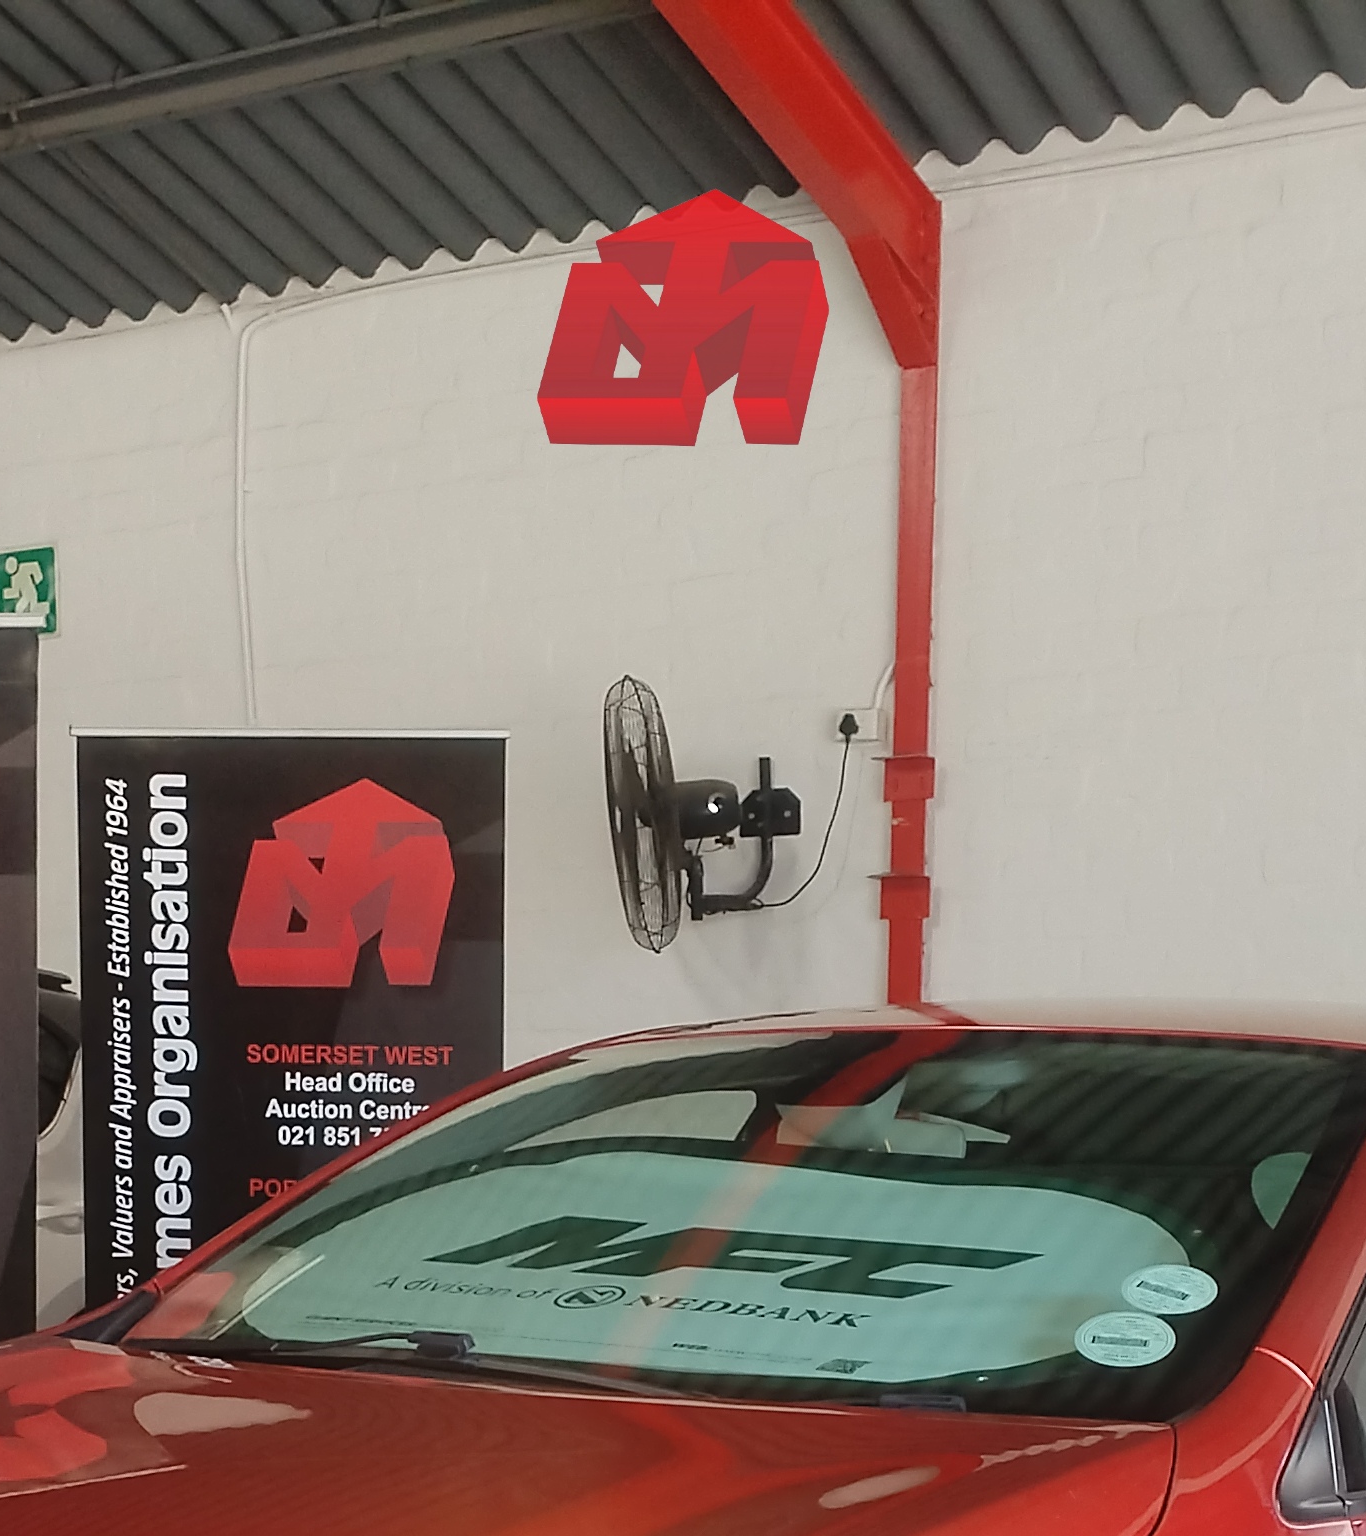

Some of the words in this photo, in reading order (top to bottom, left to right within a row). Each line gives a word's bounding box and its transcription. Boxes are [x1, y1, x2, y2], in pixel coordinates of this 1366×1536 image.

[105, 777, 129, 837] 1964
[104, 841, 130, 977] Established
[143, 772, 198, 1138] Organisation
[107, 996, 137, 1120] Appraisers
[247, 1043, 378, 1065] SOMERSET
[385, 1045, 453, 1066] WEST
[284, 1071, 342, 1093] Head
[349, 1073, 415, 1094] Office
[265, 1098, 354, 1120] Auction
[359, 1099, 430, 1120] Centr
[277, 1126, 315, 1147] 021
[323, 1126, 361, 1147] 851
[108, 1123, 134, 1169] and
[109, 1174, 134, 1258] Valuers
[154, 1154, 192, 1269] mes
[375, 1276, 400, 1289] A
[404, 1278, 511, 1296] division
[516, 1288, 560, 1299] of
[623, 1295, 872, 1328] NEDBANK
